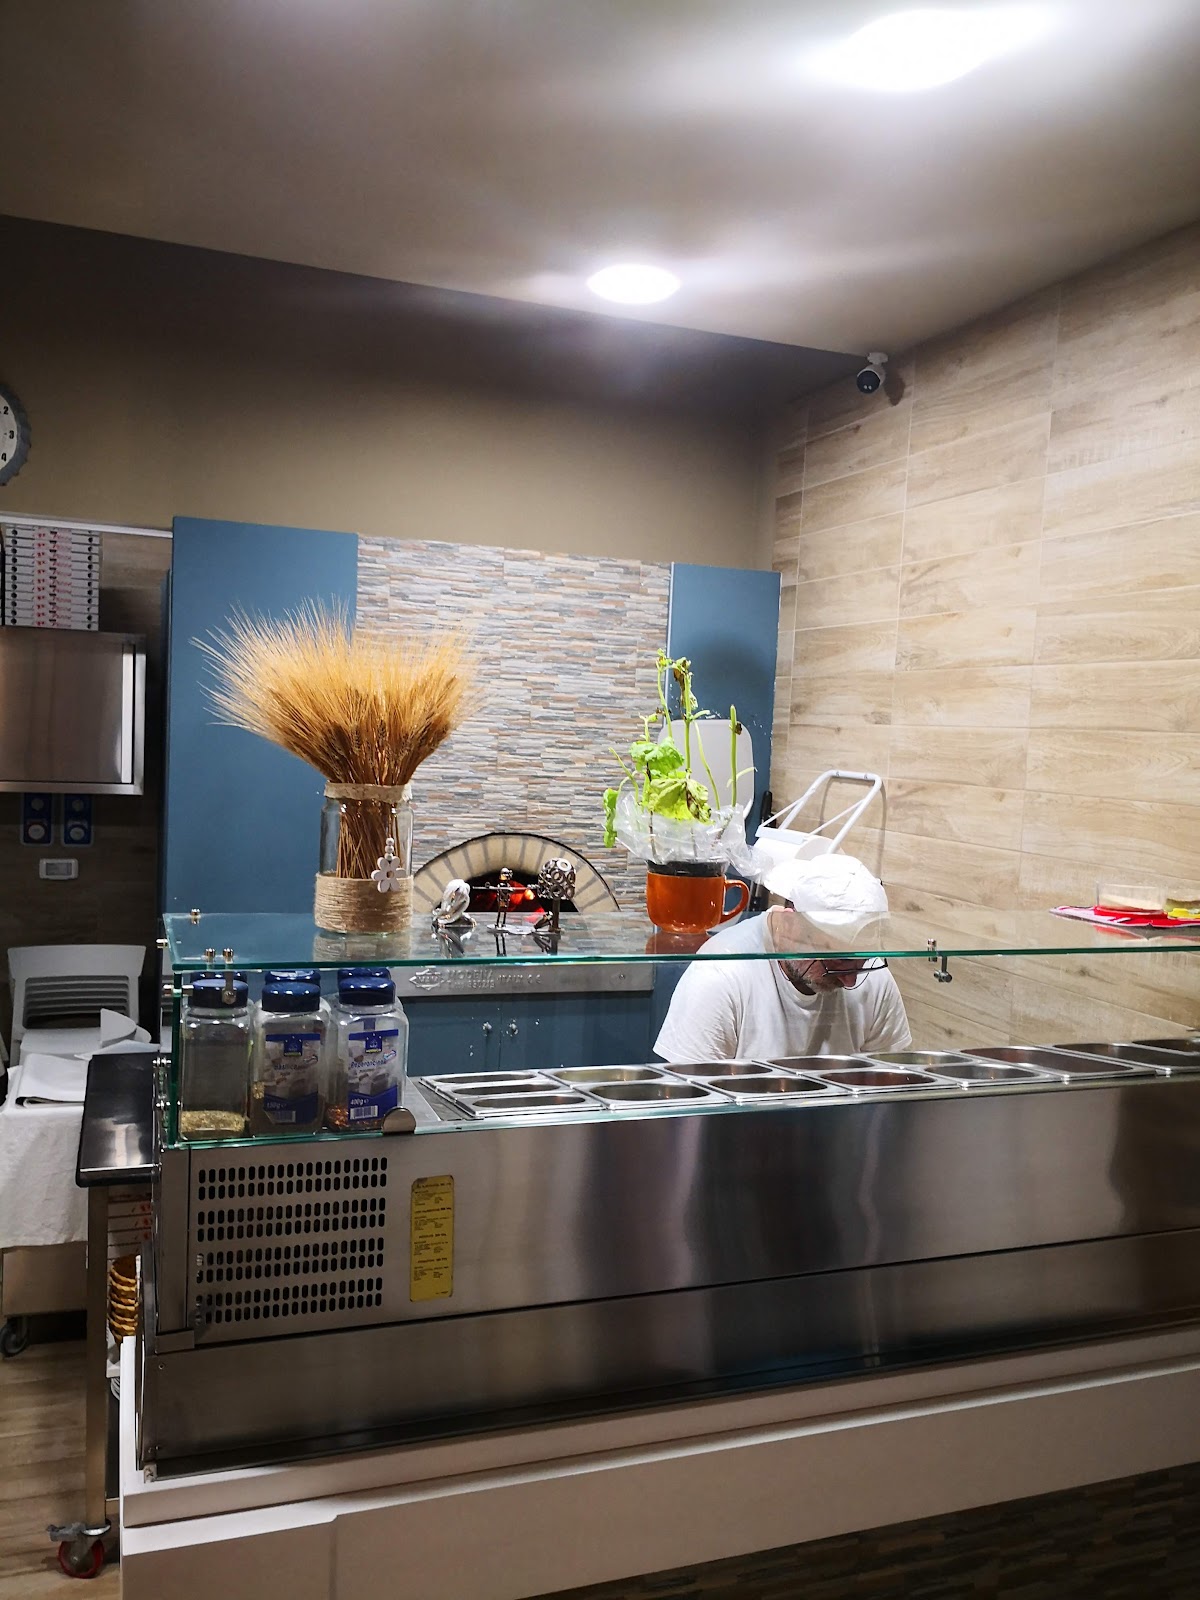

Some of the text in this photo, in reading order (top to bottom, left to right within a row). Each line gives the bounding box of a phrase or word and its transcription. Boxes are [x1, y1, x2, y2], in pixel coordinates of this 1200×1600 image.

[3, 406, 9, 416] 2
[9, 430, 15, 440] 3
[1, 452, 7, 462] 4
